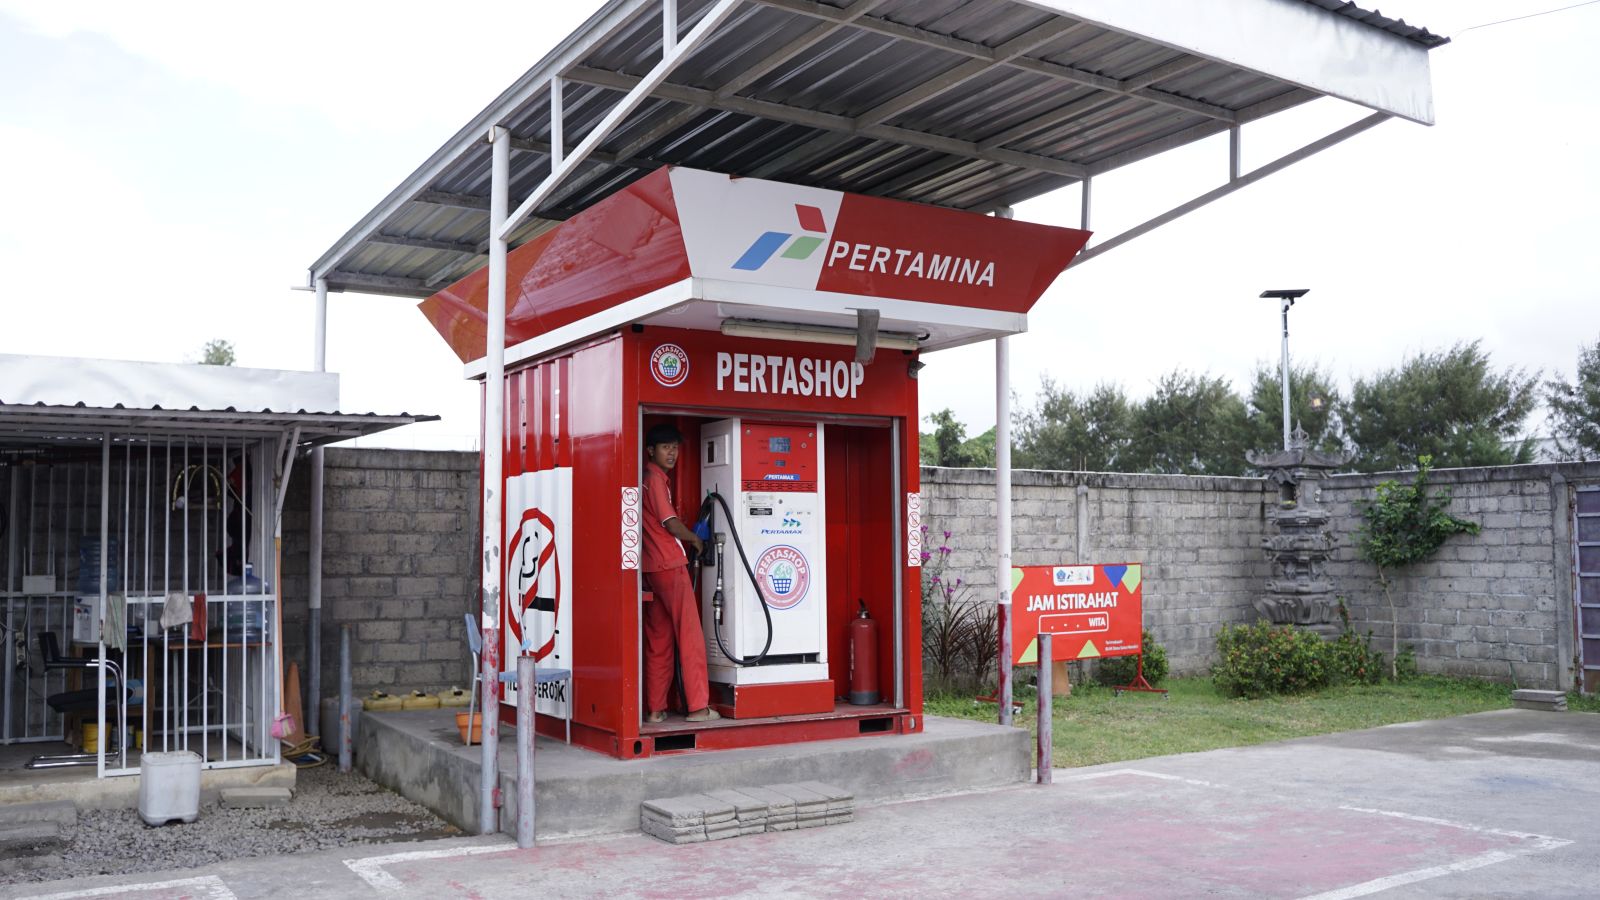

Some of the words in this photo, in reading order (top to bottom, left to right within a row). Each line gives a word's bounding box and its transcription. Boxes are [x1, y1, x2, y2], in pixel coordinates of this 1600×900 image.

[828, 241, 996, 287] PERTAMINA
[653, 346, 686, 363] PERTASHOP
[716, 351, 865, 399] PERTASHOP
[758, 549, 806, 576] PERTASHOP
[1026, 594, 1055, 612] JAM
[1057, 592, 1119, 610] ISTIRAHAT
[1088, 617, 1106, 627] WITA
